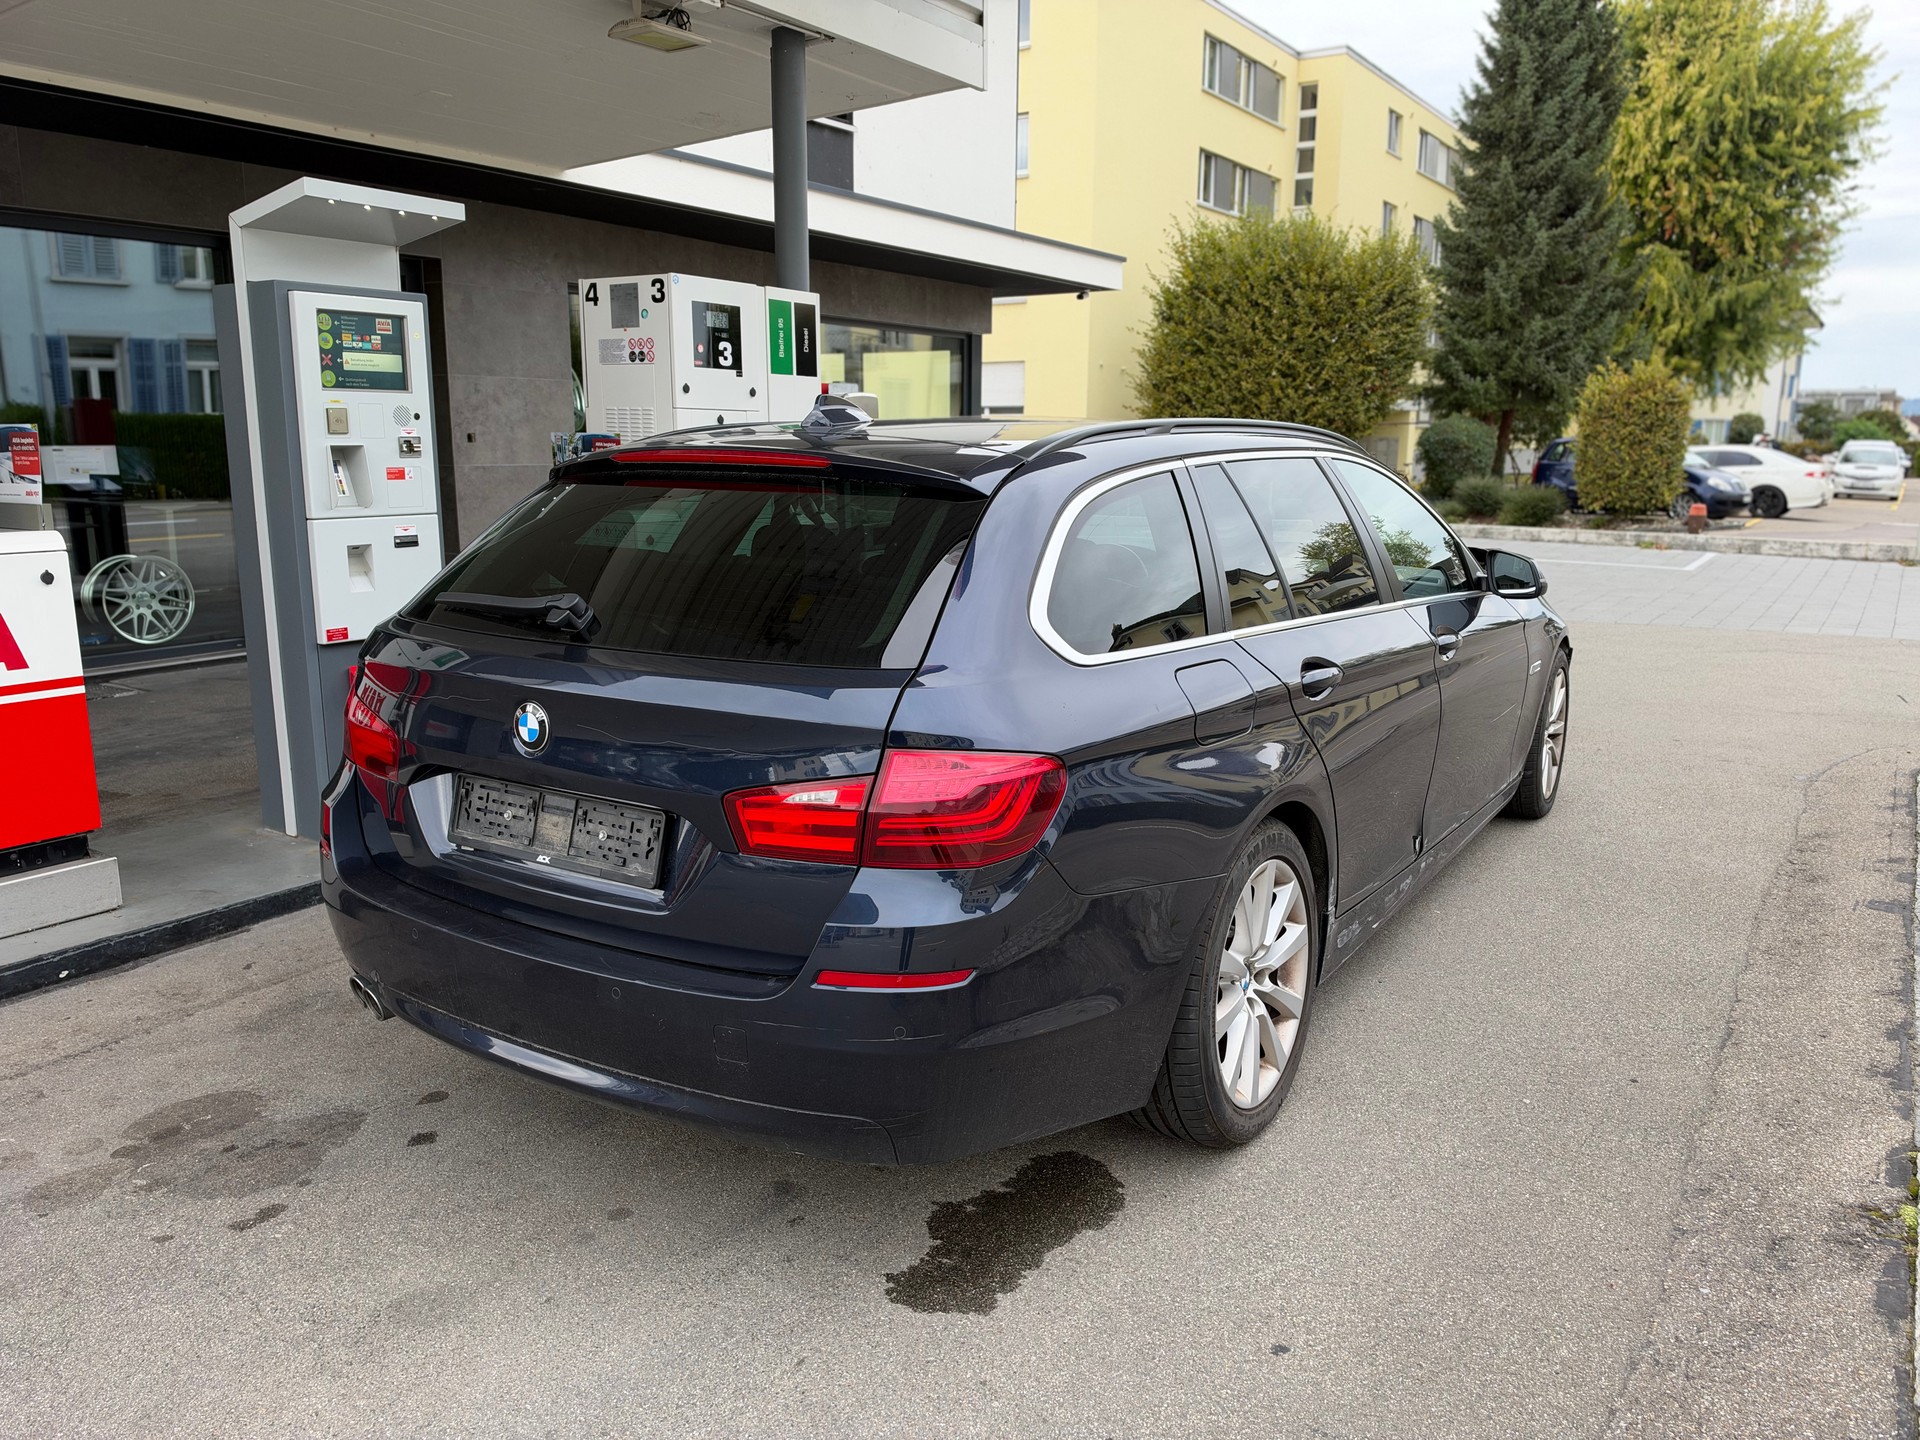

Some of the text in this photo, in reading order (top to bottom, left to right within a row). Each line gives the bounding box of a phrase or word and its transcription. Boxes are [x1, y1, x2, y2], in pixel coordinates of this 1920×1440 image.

[585, 282, 599, 306] 4
[651, 278, 665, 303] 3
[778, 318, 784, 328] 95
[718, 341, 733, 367] 3
[516, 704, 545, 721] BMW
